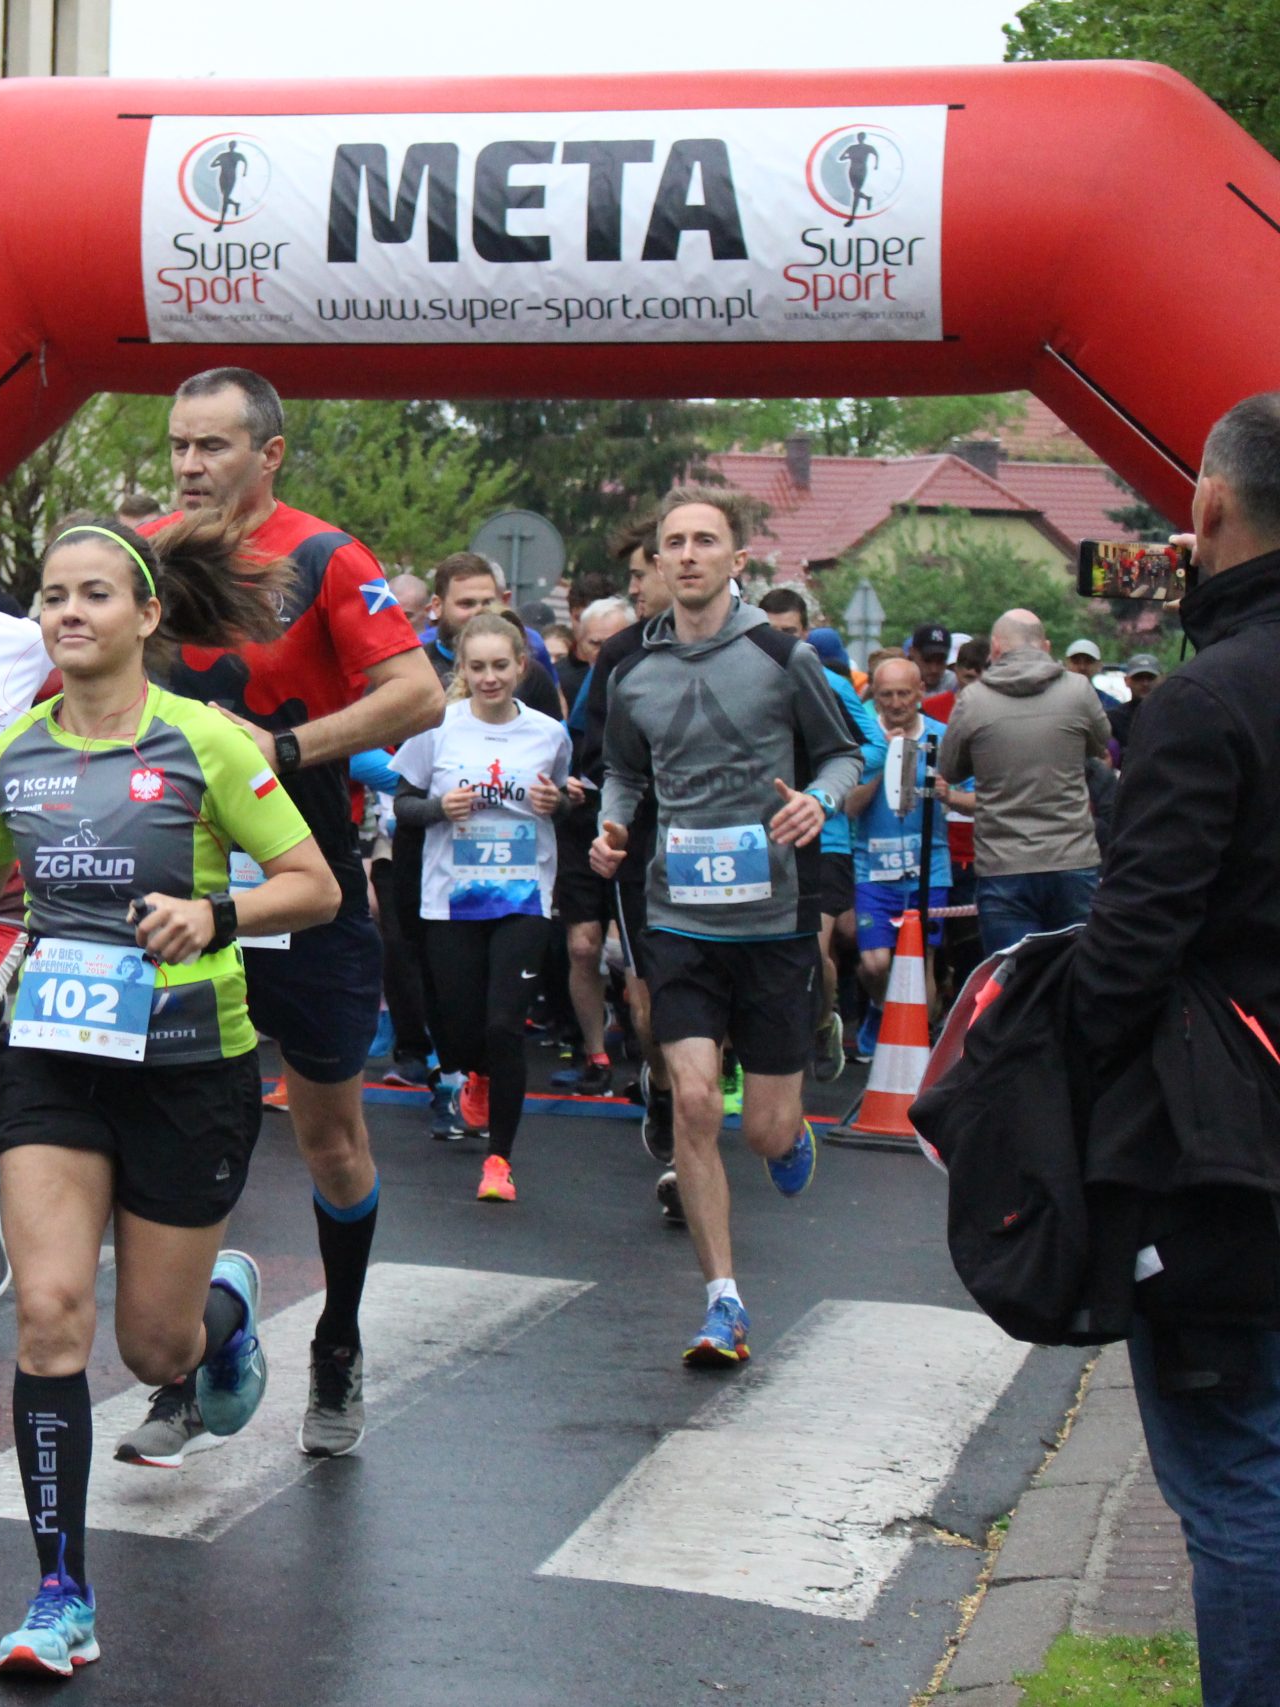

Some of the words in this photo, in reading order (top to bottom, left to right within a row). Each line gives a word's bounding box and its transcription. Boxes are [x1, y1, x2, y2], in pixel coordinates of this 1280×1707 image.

[327, 138, 749, 263] META
[173, 232, 291, 278] Super
[801, 227, 926, 274] Super
[157, 267, 265, 314] Sport
[317, 288, 760, 327] www.super-sport.com.pl
[783, 264, 897, 311] Sport
[23, 775, 78, 792] KGHM
[34, 853, 136, 879] ZGRun
[475, 841, 513, 864] 75
[694, 855, 737, 884] 18
[59, 948, 83, 962] BIEG
[37, 977, 120, 1024] 102
